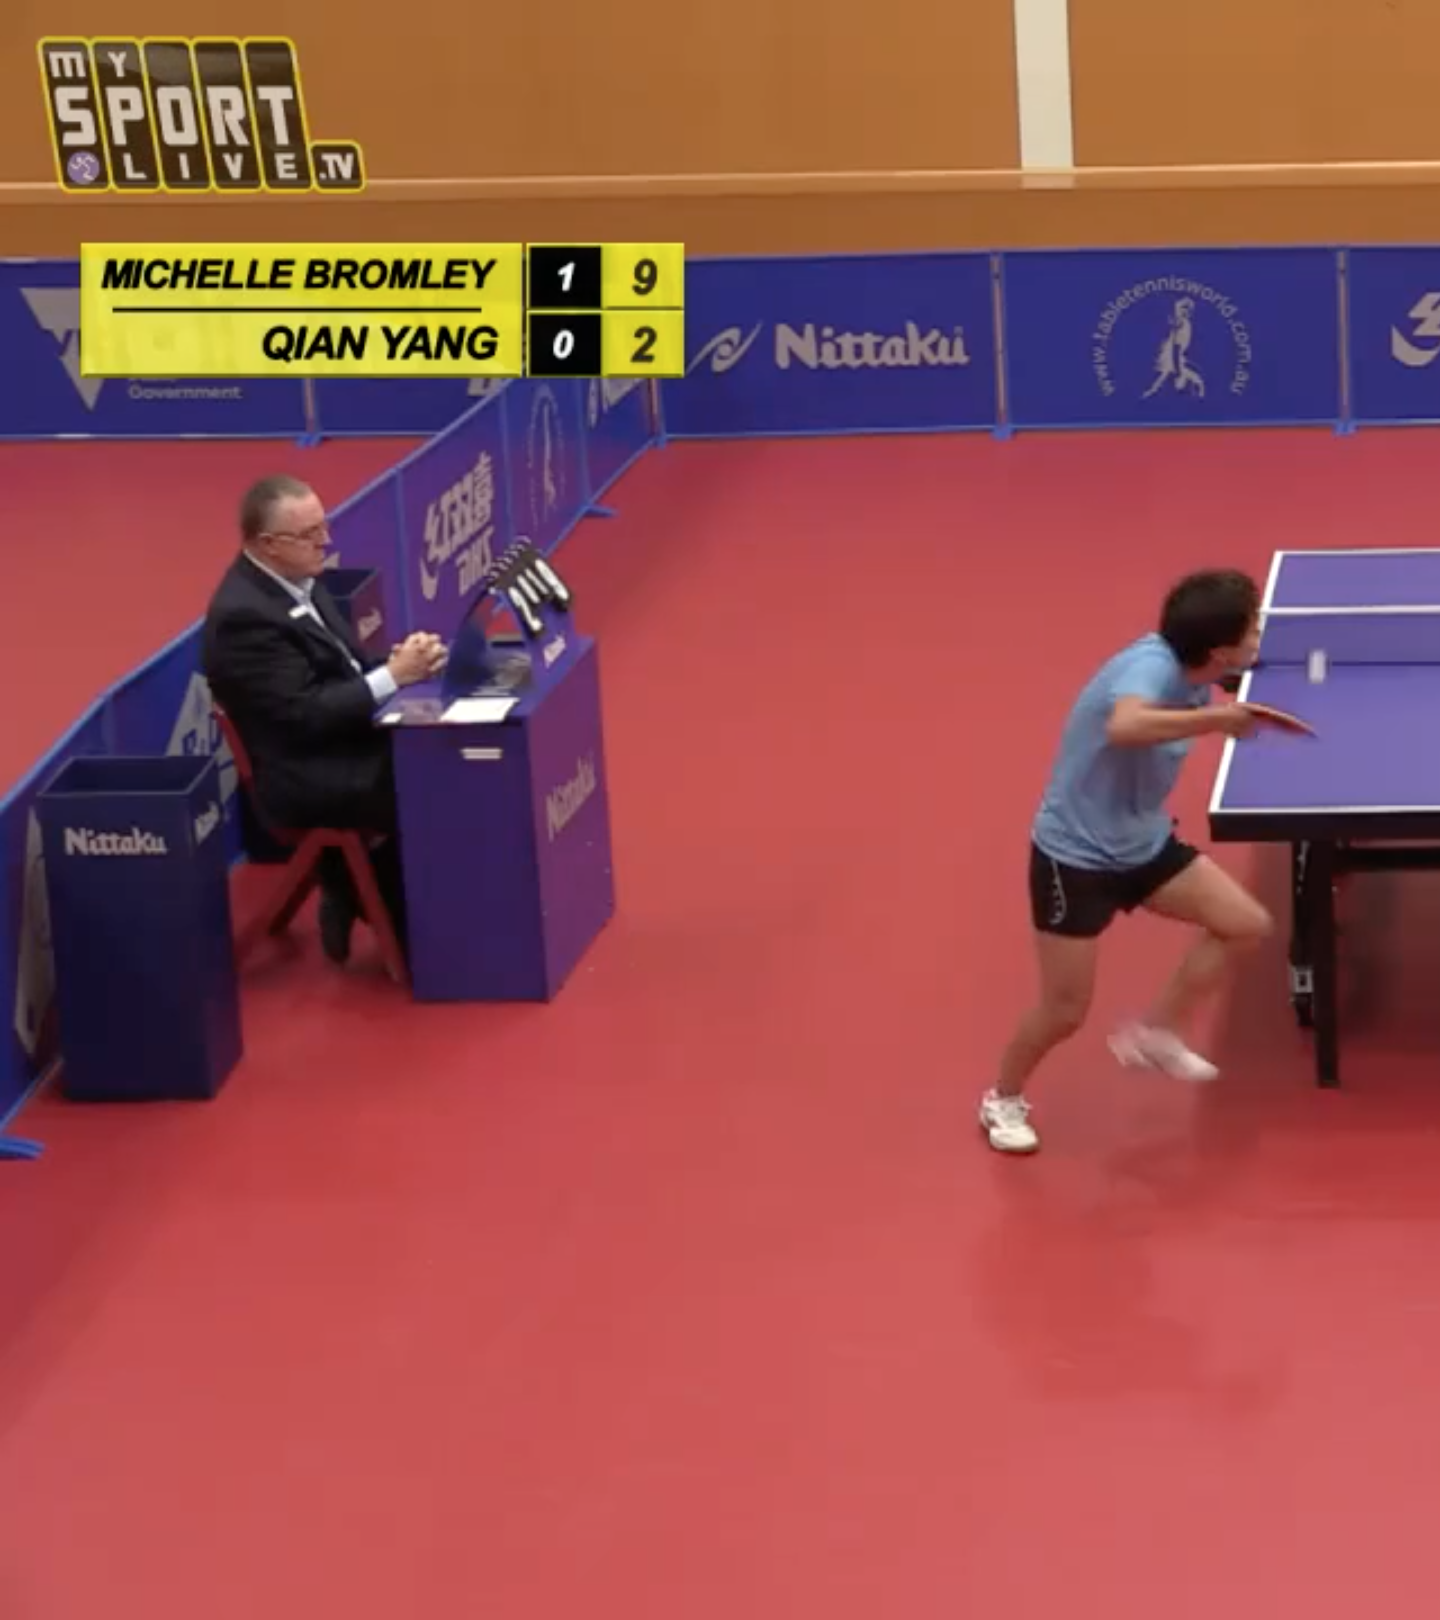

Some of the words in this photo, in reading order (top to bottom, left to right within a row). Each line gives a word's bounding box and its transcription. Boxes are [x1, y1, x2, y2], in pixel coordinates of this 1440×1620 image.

[775, 320, 970, 370] Nittaku
[128, 383, 242, 401] Government
[64, 826, 167, 856] Nittaku
